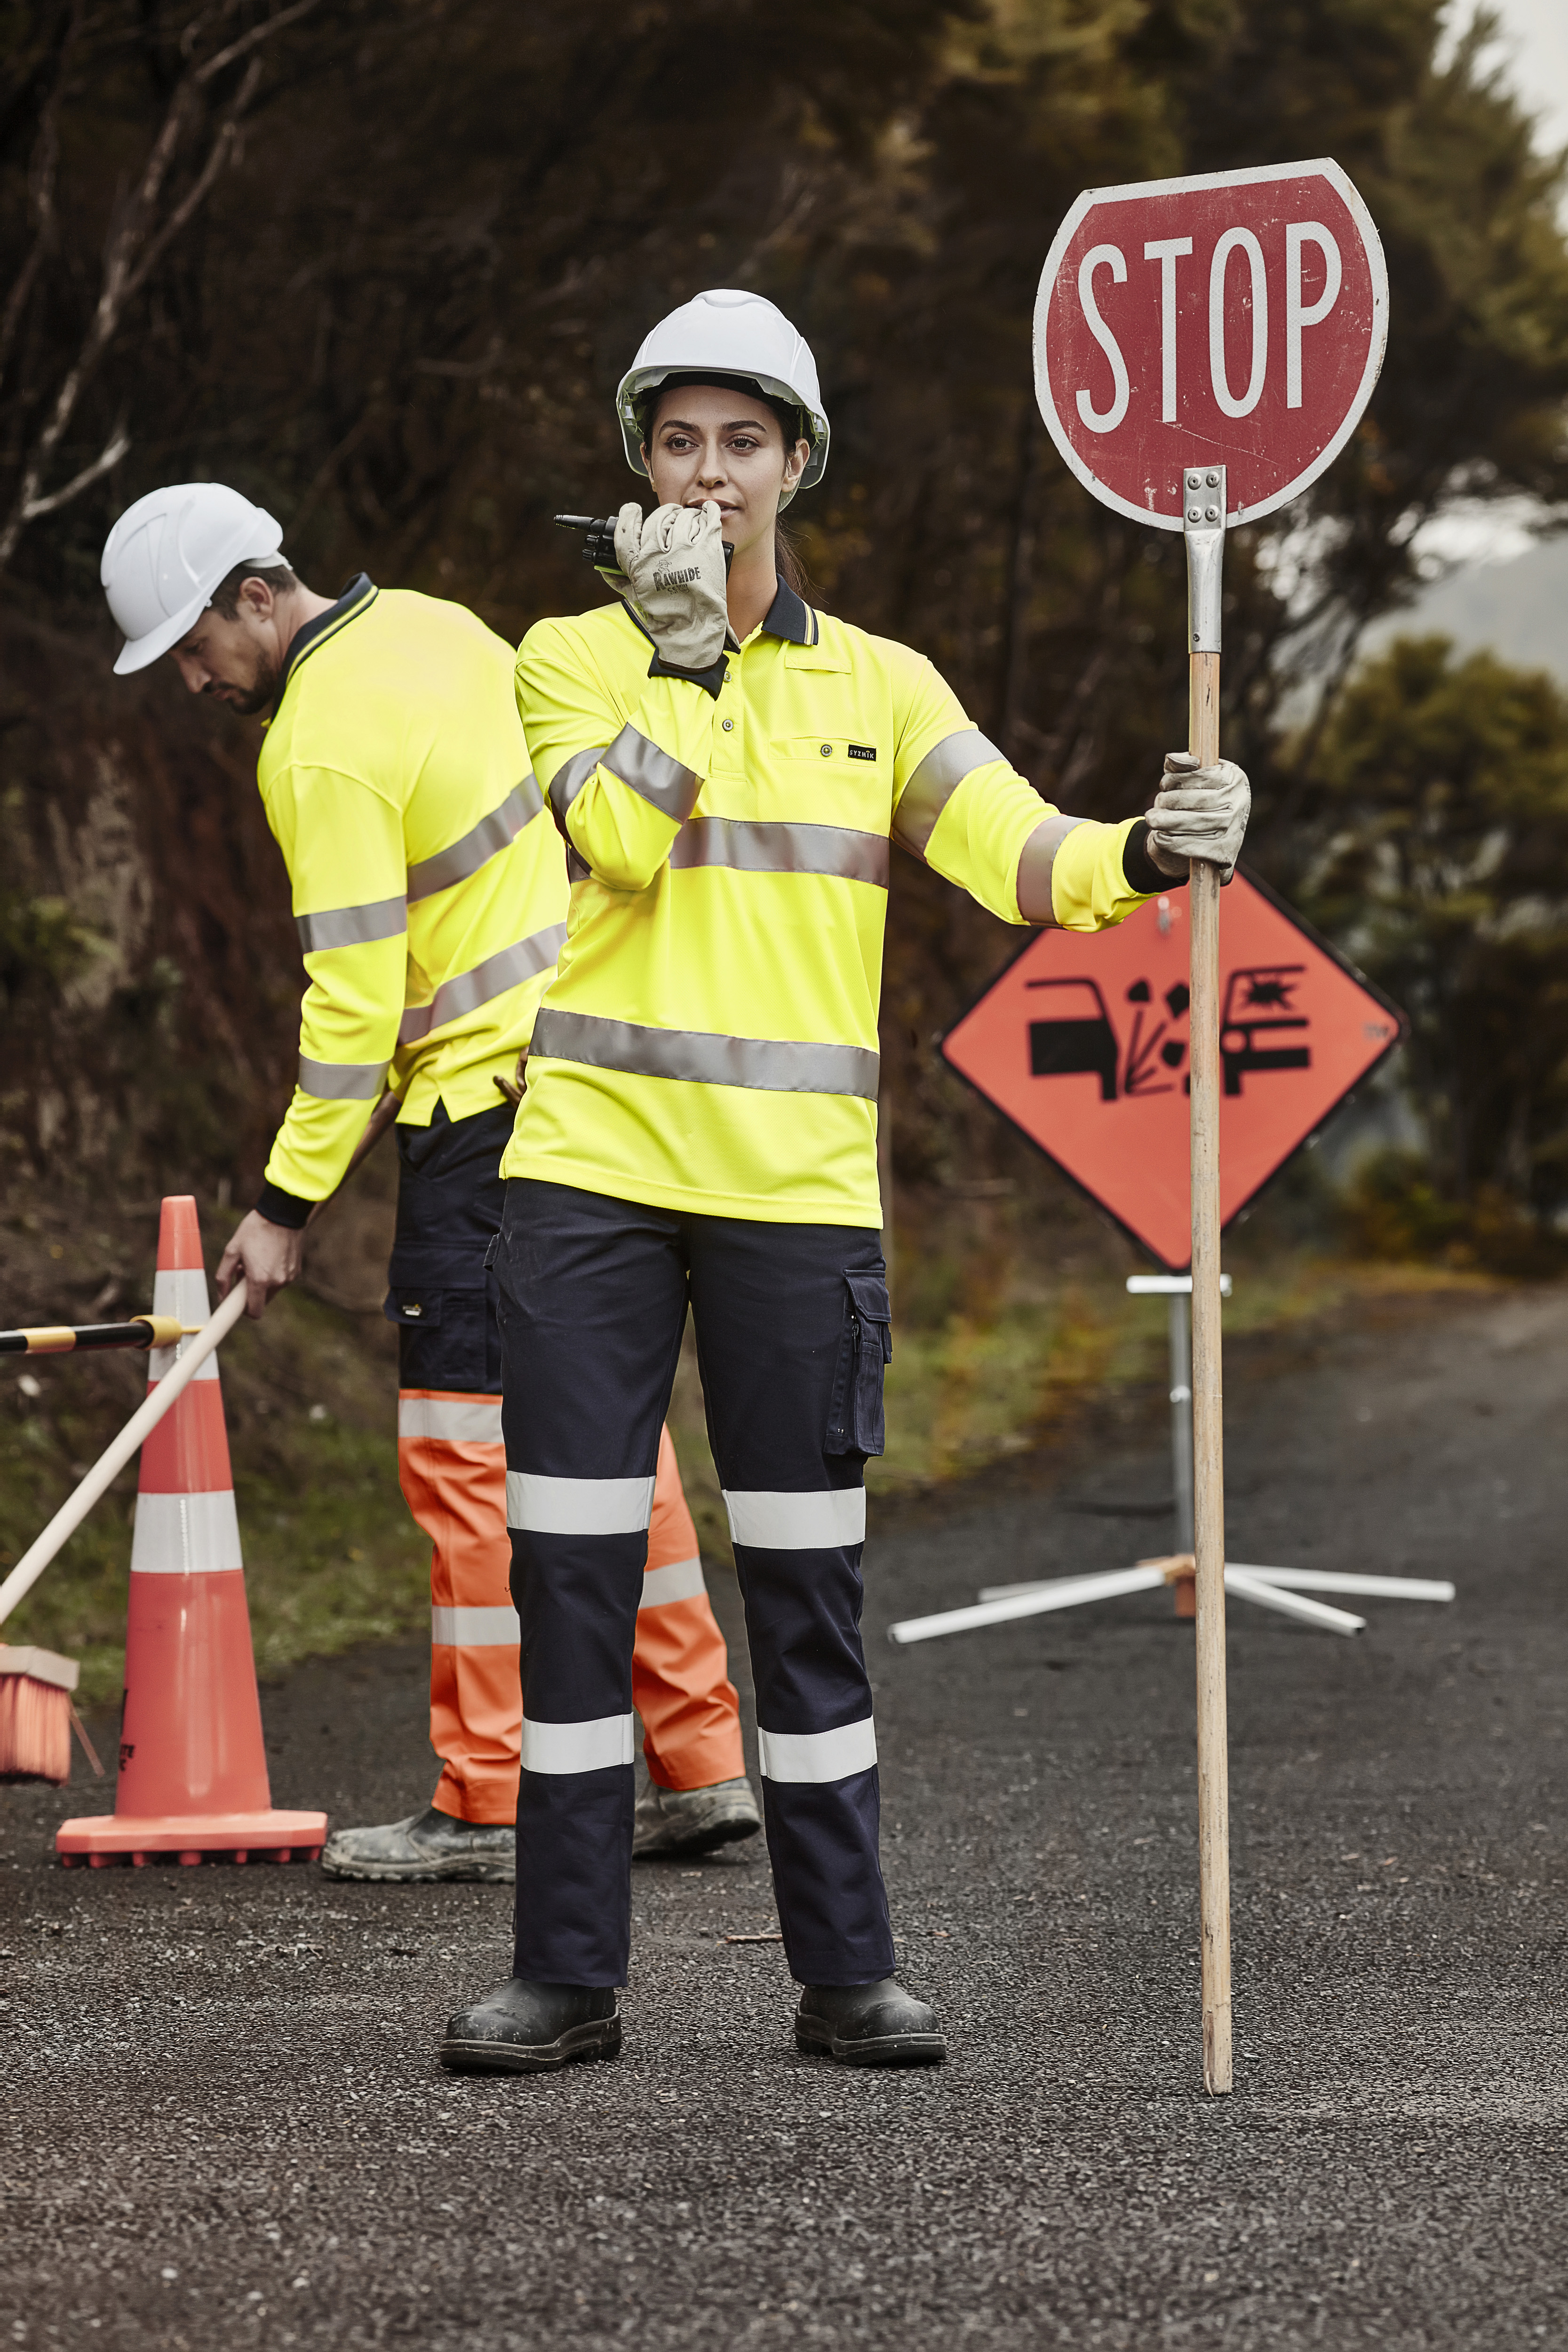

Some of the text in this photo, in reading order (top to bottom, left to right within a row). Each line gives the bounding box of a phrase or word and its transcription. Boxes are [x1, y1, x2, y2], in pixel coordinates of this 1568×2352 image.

[1075, 221, 1342, 434] STOP
[653, 567, 701, 591] RAWHIDE
[849, 750, 874, 759] SYZMIK
